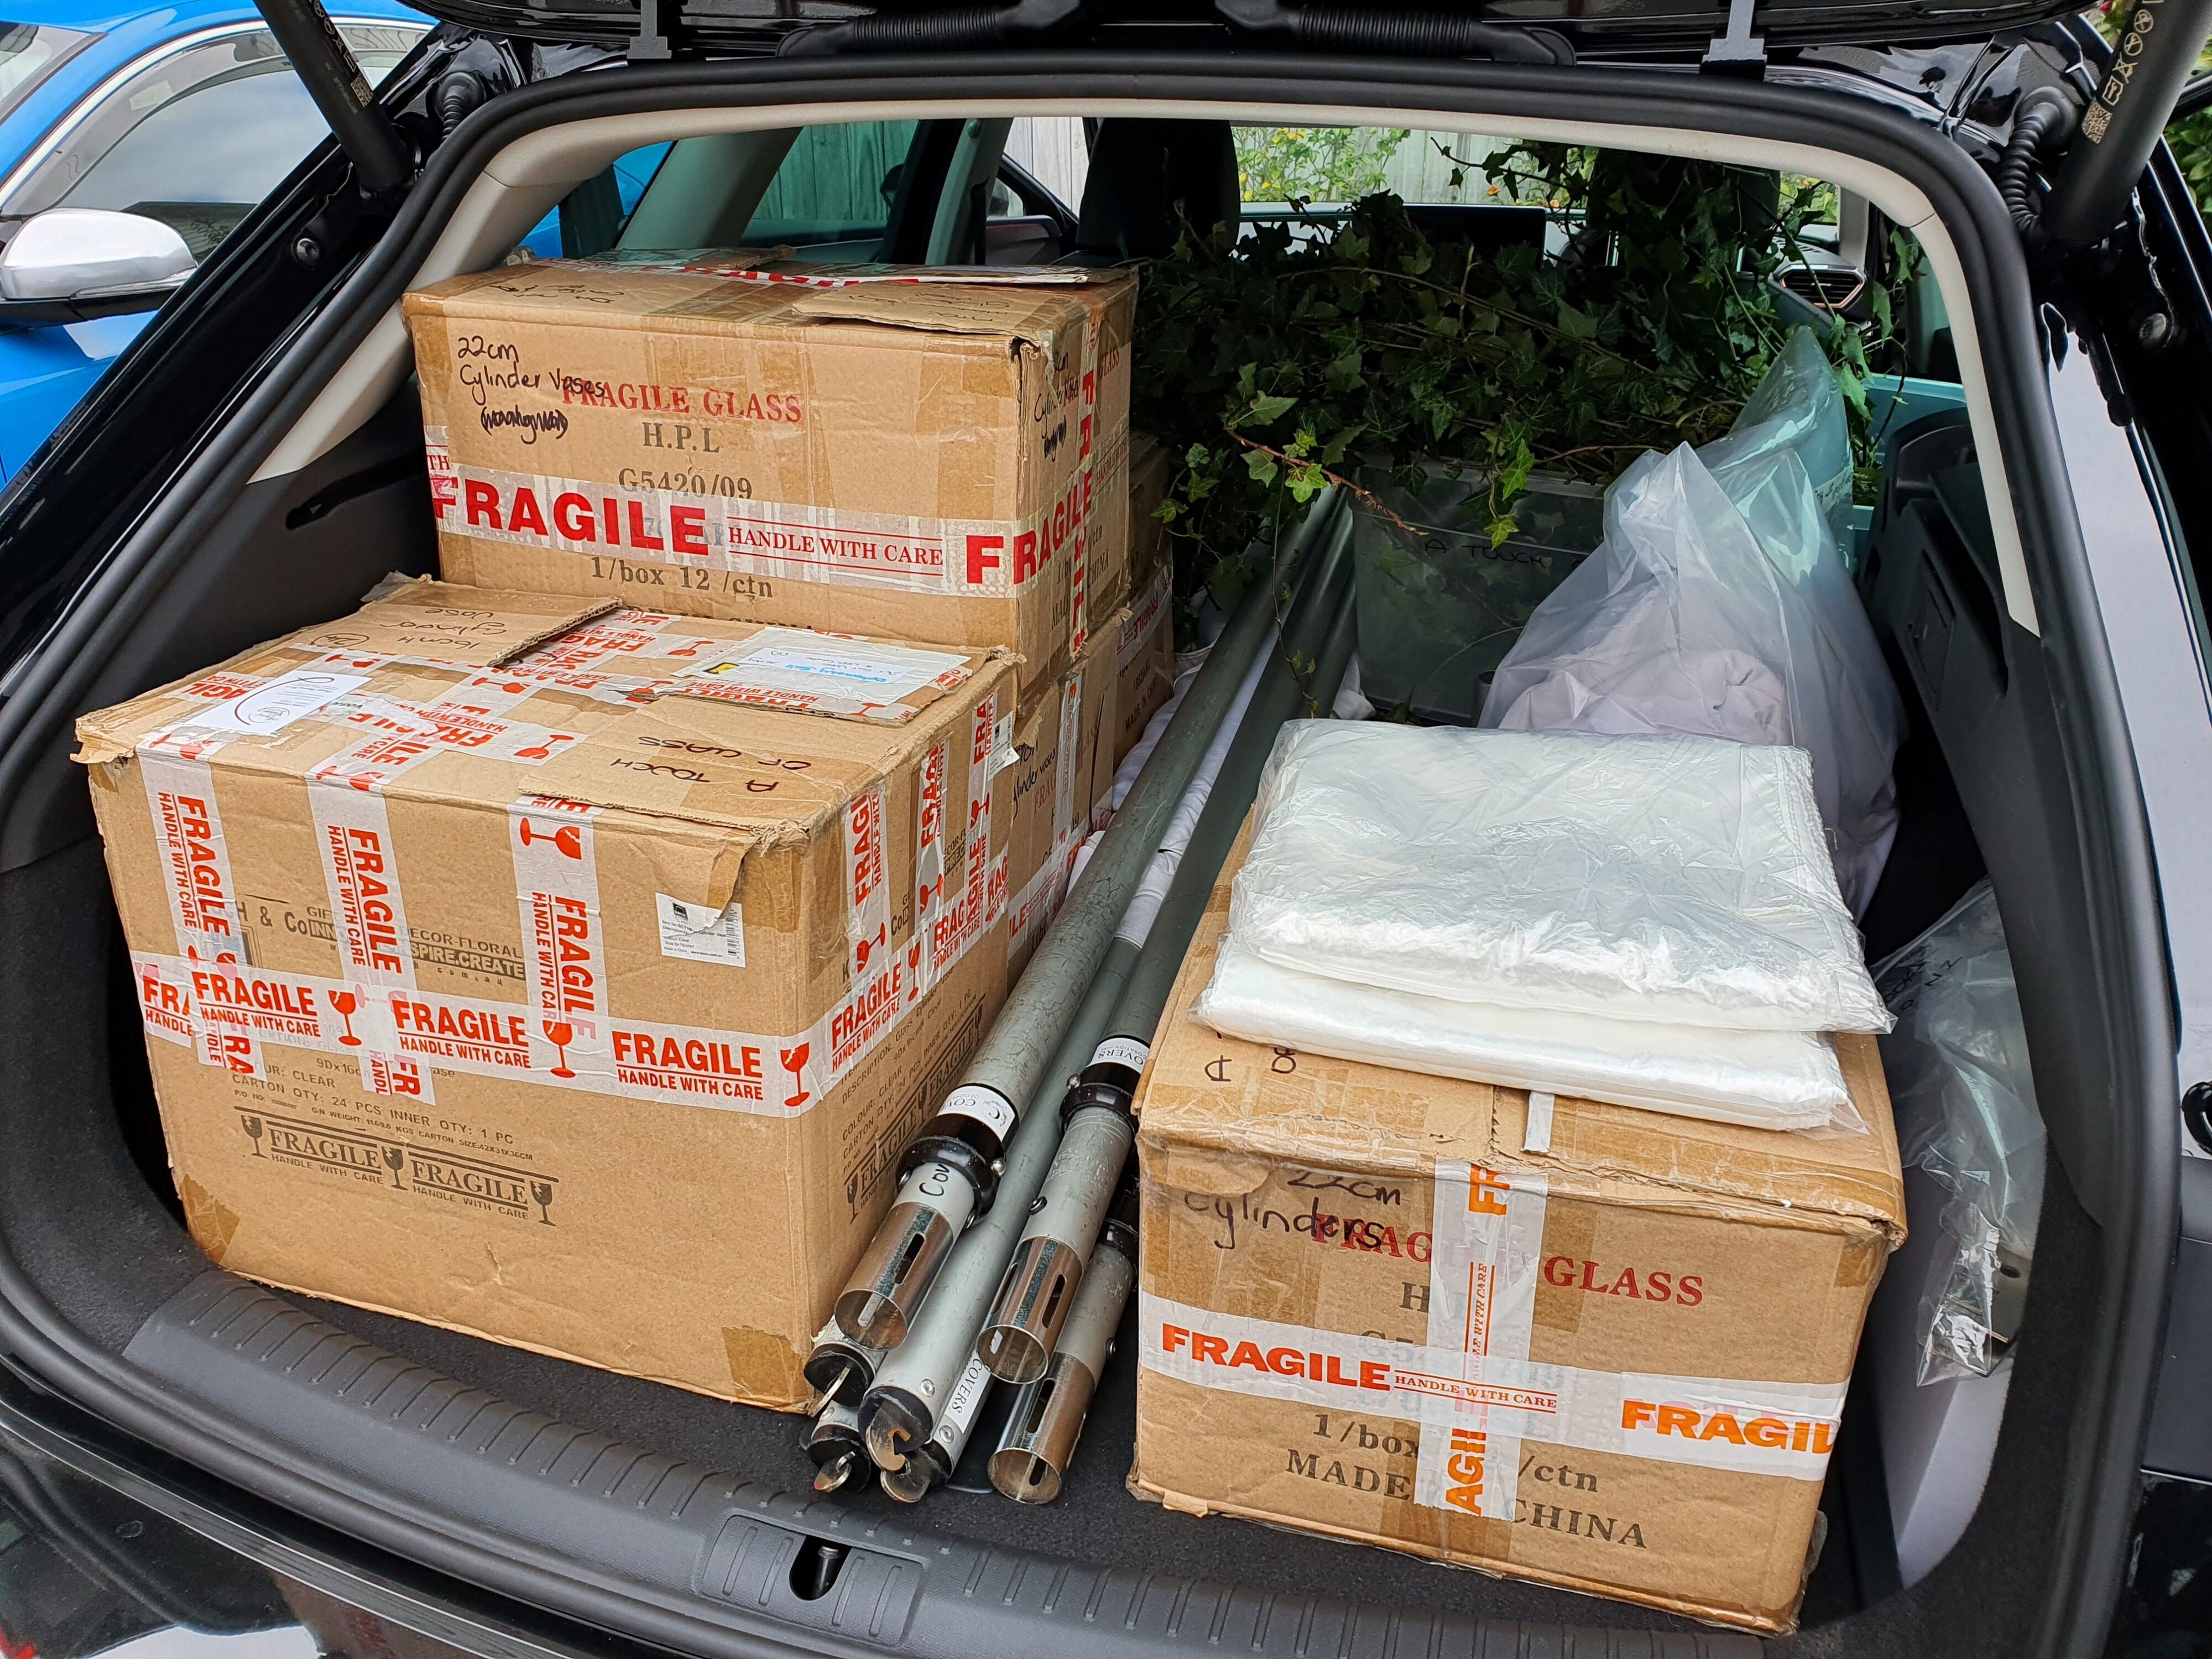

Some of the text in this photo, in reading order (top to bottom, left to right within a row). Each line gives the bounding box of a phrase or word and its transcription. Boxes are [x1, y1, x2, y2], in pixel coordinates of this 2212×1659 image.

[457, 335, 519, 362] 22cm
[460, 362, 540, 405] Cylinder
[562, 378, 802, 423] FRAGILE GLASS
[642, 422, 721, 454] H.P.L
[618, 468, 753, 499] G5420/09
[432, 477, 709, 556] FRAGILE
[728, 528, 815, 553] HANDLE
[818, 538, 878, 560] WITH
[884, 545, 943, 567] CARE
[1462, 545, 1546, 569] TOUCH
[591, 556, 665, 586] 1/box
[680, 566, 711, 590] 12
[737, 686, 763, 695] WITH
[765, 690, 820, 702] HANDLE
[610, 758, 779, 792] A TOUCH
[158, 792, 197, 928] HANDLE WITH CARE
[178, 796, 230, 936] FRAGILE
[851, 794, 871, 906] FRAGI
[327, 825, 366, 966] HANDLE WITH CARE
[349, 829, 402, 974] FRAGILE
[410, 927, 524, 959] ECOR-FLORAL
[968, 916, 980, 938] CARE
[532, 891, 556, 1020] HANDLE WITH CAR
[191, 971, 317, 1017] FRAGILE
[832, 962, 901, 1051] FRAGILE
[145, 1008, 192, 1037] HANDLE
[200, 1006, 321, 1037] HANDLE WITH CARE
[392, 1000, 529, 1047] FRAGILE
[832, 1037, 860, 1073] HANDLE
[863, 1017, 880, 1042] WITH
[882, 1000, 900, 1025] CARE
[316, 1058, 361, 1076] 9Dx16c
[399, 1036, 531, 1068] HANDLE WITH CARE
[612, 1031, 763, 1078] FRAGILE
[842, 1043, 892, 1104] DESCRIPTION:
[930, 1027, 975, 1099] FRAGILE
[1098, 1050, 1144, 1065] OVERS
[293, 1071, 336, 1088] CLEAR
[618, 1069, 764, 1100] HANDLE WITH CARE
[843, 1119, 874, 1160] CARTON
[909, 1060, 921, 1078] PCS
[924, 1030, 941, 1058] INNER
[232, 1074, 514, 1145] CARTON QTY: 24 PCS INNER QTY: 1 PC
[843, 1098, 876, 1141] COLOUR:
[879, 1066, 902, 1098] CLEAR
[268, 1128, 382, 1169] FRAGILE
[396, 1126, 414, 1135] KGS
[419, 1131, 454, 1144] CARTON
[861, 1104, 917, 1187] FRAGILE
[272, 1154, 384, 1185] HANDLE WITH CARE
[410, 1159, 528, 1205] FRAGILE
[1287, 1169, 1400, 1206] 22cm
[413, 1185, 529, 1220] HANDLE WITH CARE
[1312, 1213, 1704, 1307] FRAG GLASS
[1476, 1263, 1488, 1295] CARE
[952, 1359, 983, 1413] COVERS
[1162, 1323, 1391, 1391] FRAGILE
[1395, 1375, 1460, 1394] HANDLE
[1465, 1387, 1510, 1402] WITH
[1513, 1394, 1558, 1409] CARE
[1621, 1399, 1835, 1455] FRAGIL
[1286, 1449, 1648, 1550] MADE CHINA
